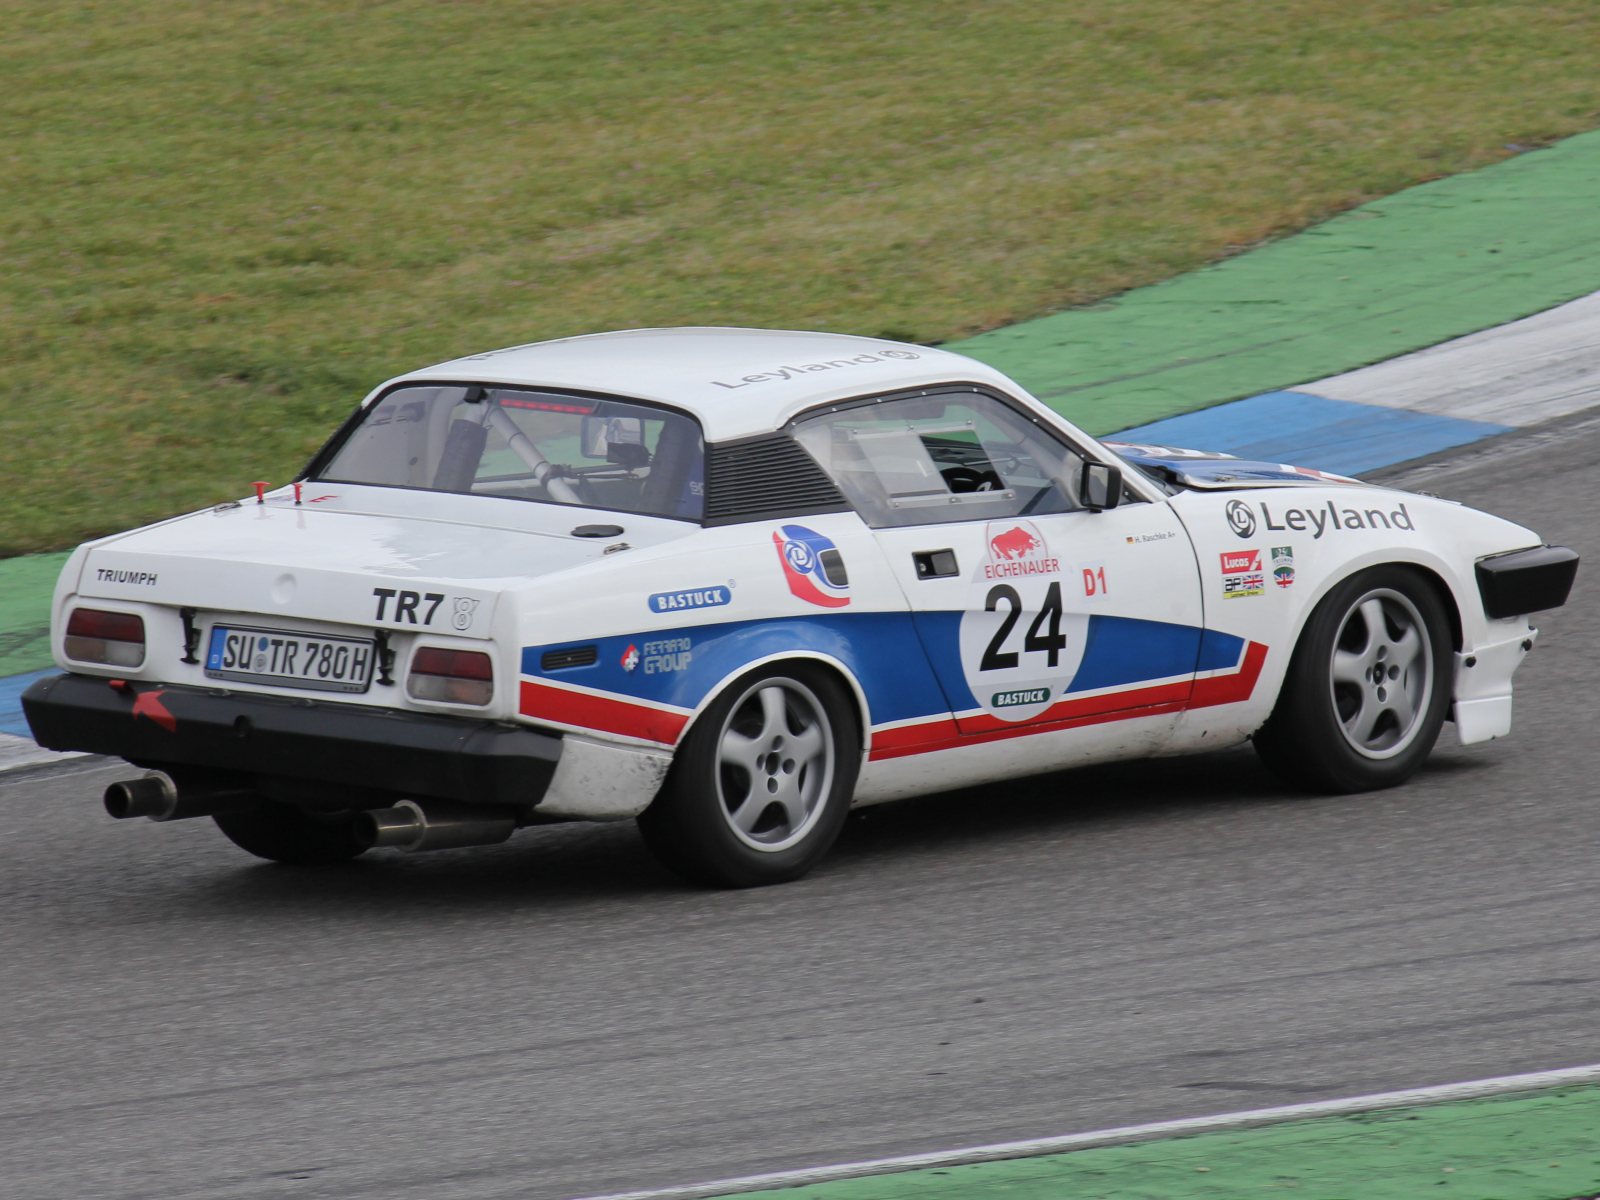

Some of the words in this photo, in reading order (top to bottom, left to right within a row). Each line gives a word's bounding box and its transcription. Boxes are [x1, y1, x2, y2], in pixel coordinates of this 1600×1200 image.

[711, 354, 884, 389] Leyland
[1259, 500, 1416, 540] Leyland
[985, 558, 1061, 579] EICHENAUER
[1223, 556, 1250, 569] Lucas
[97, 568, 158, 586] TRIUMPH
[1083, 566, 1107, 597] D1
[373, 588, 445, 625] TR7
[657, 590, 723, 610] BASTUCK
[979, 581, 1067, 672] 24
[223, 635, 255, 670] SU
[270, 638, 299, 675] TR
[644, 652, 692, 675] GROUP
[997, 690, 1045, 705] BASTUCK
